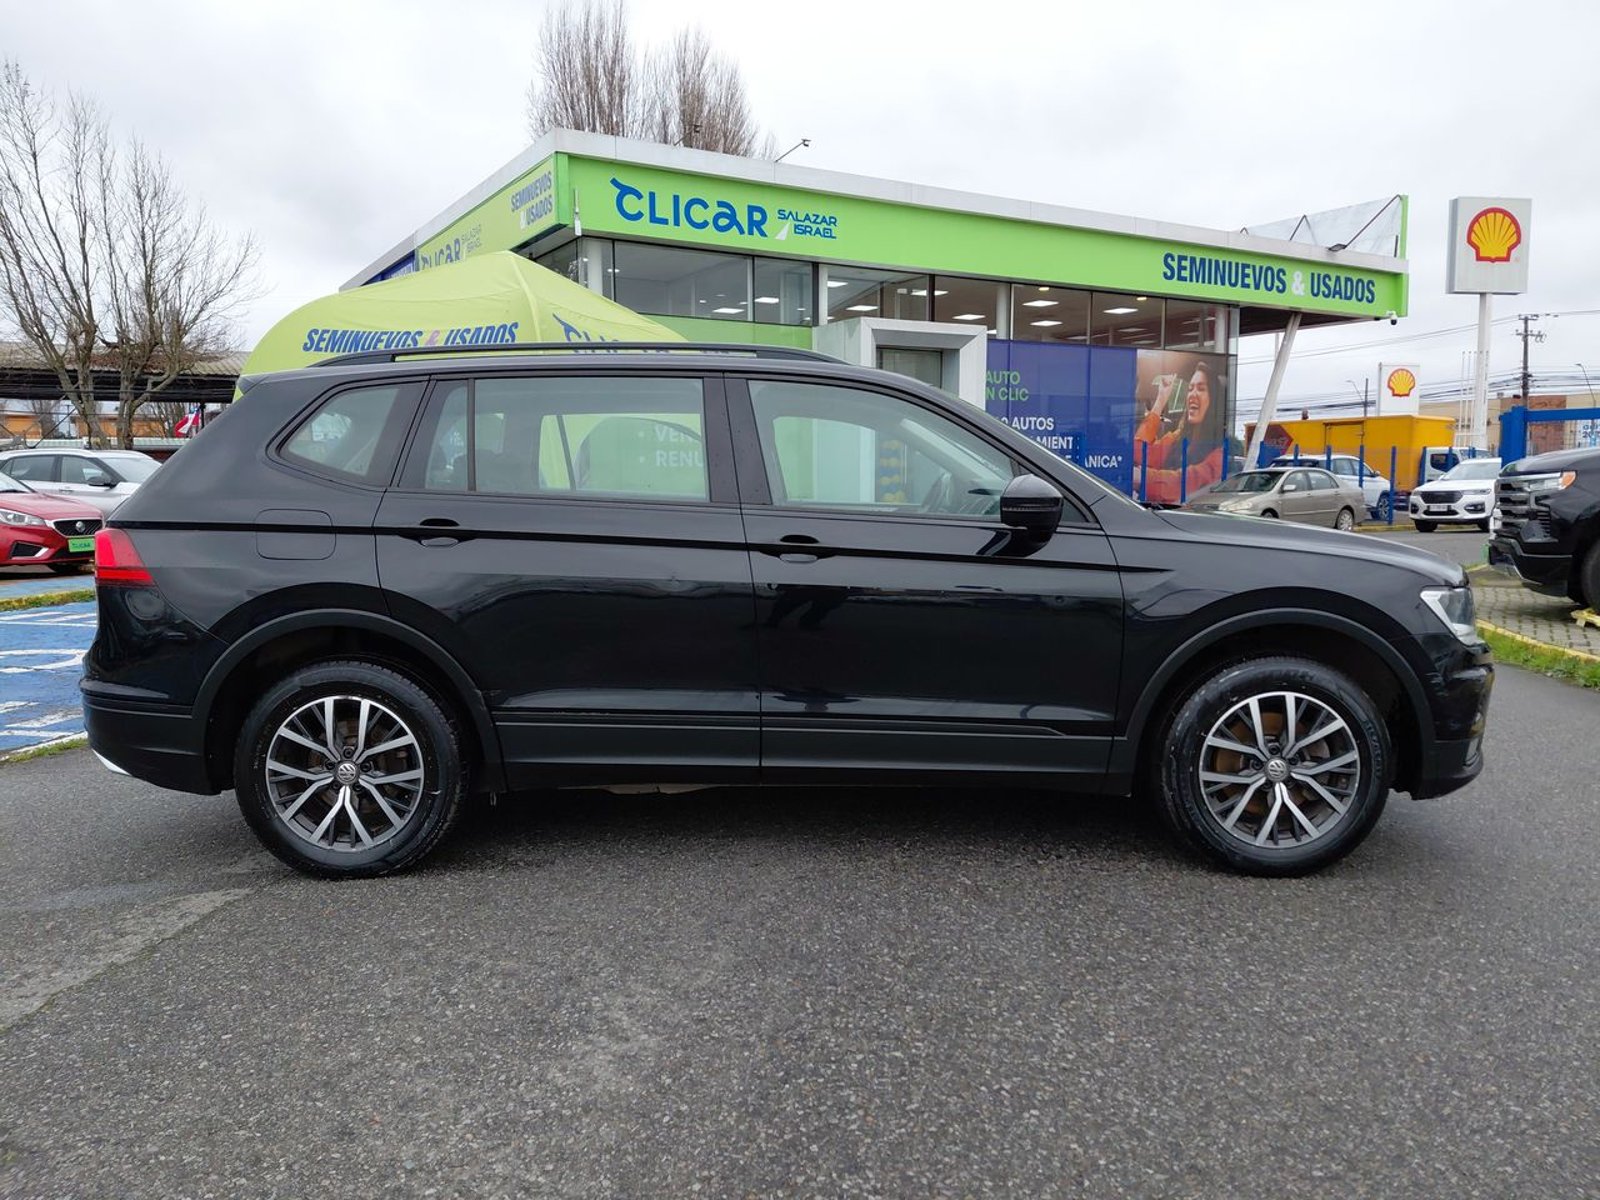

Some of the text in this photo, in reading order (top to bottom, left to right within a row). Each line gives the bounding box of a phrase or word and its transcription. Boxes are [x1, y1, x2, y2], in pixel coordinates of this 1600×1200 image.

[511, 170, 552, 213] SEMINUEVOS
[526, 194, 553, 226] USADOS
[777, 209, 838, 227] SALAZAR
[794, 224, 838, 240] ISRAEL
[1163, 252, 1376, 304] SEMINUEVOS & USADOS
[303, 328, 423, 353] SEMINUEVOS
[444, 322, 519, 346] USADOS
[986, 371, 1021, 385] AUTO
[998, 388, 1029, 401] CLIC
[1011, 417, 1055, 431] AUTOS
